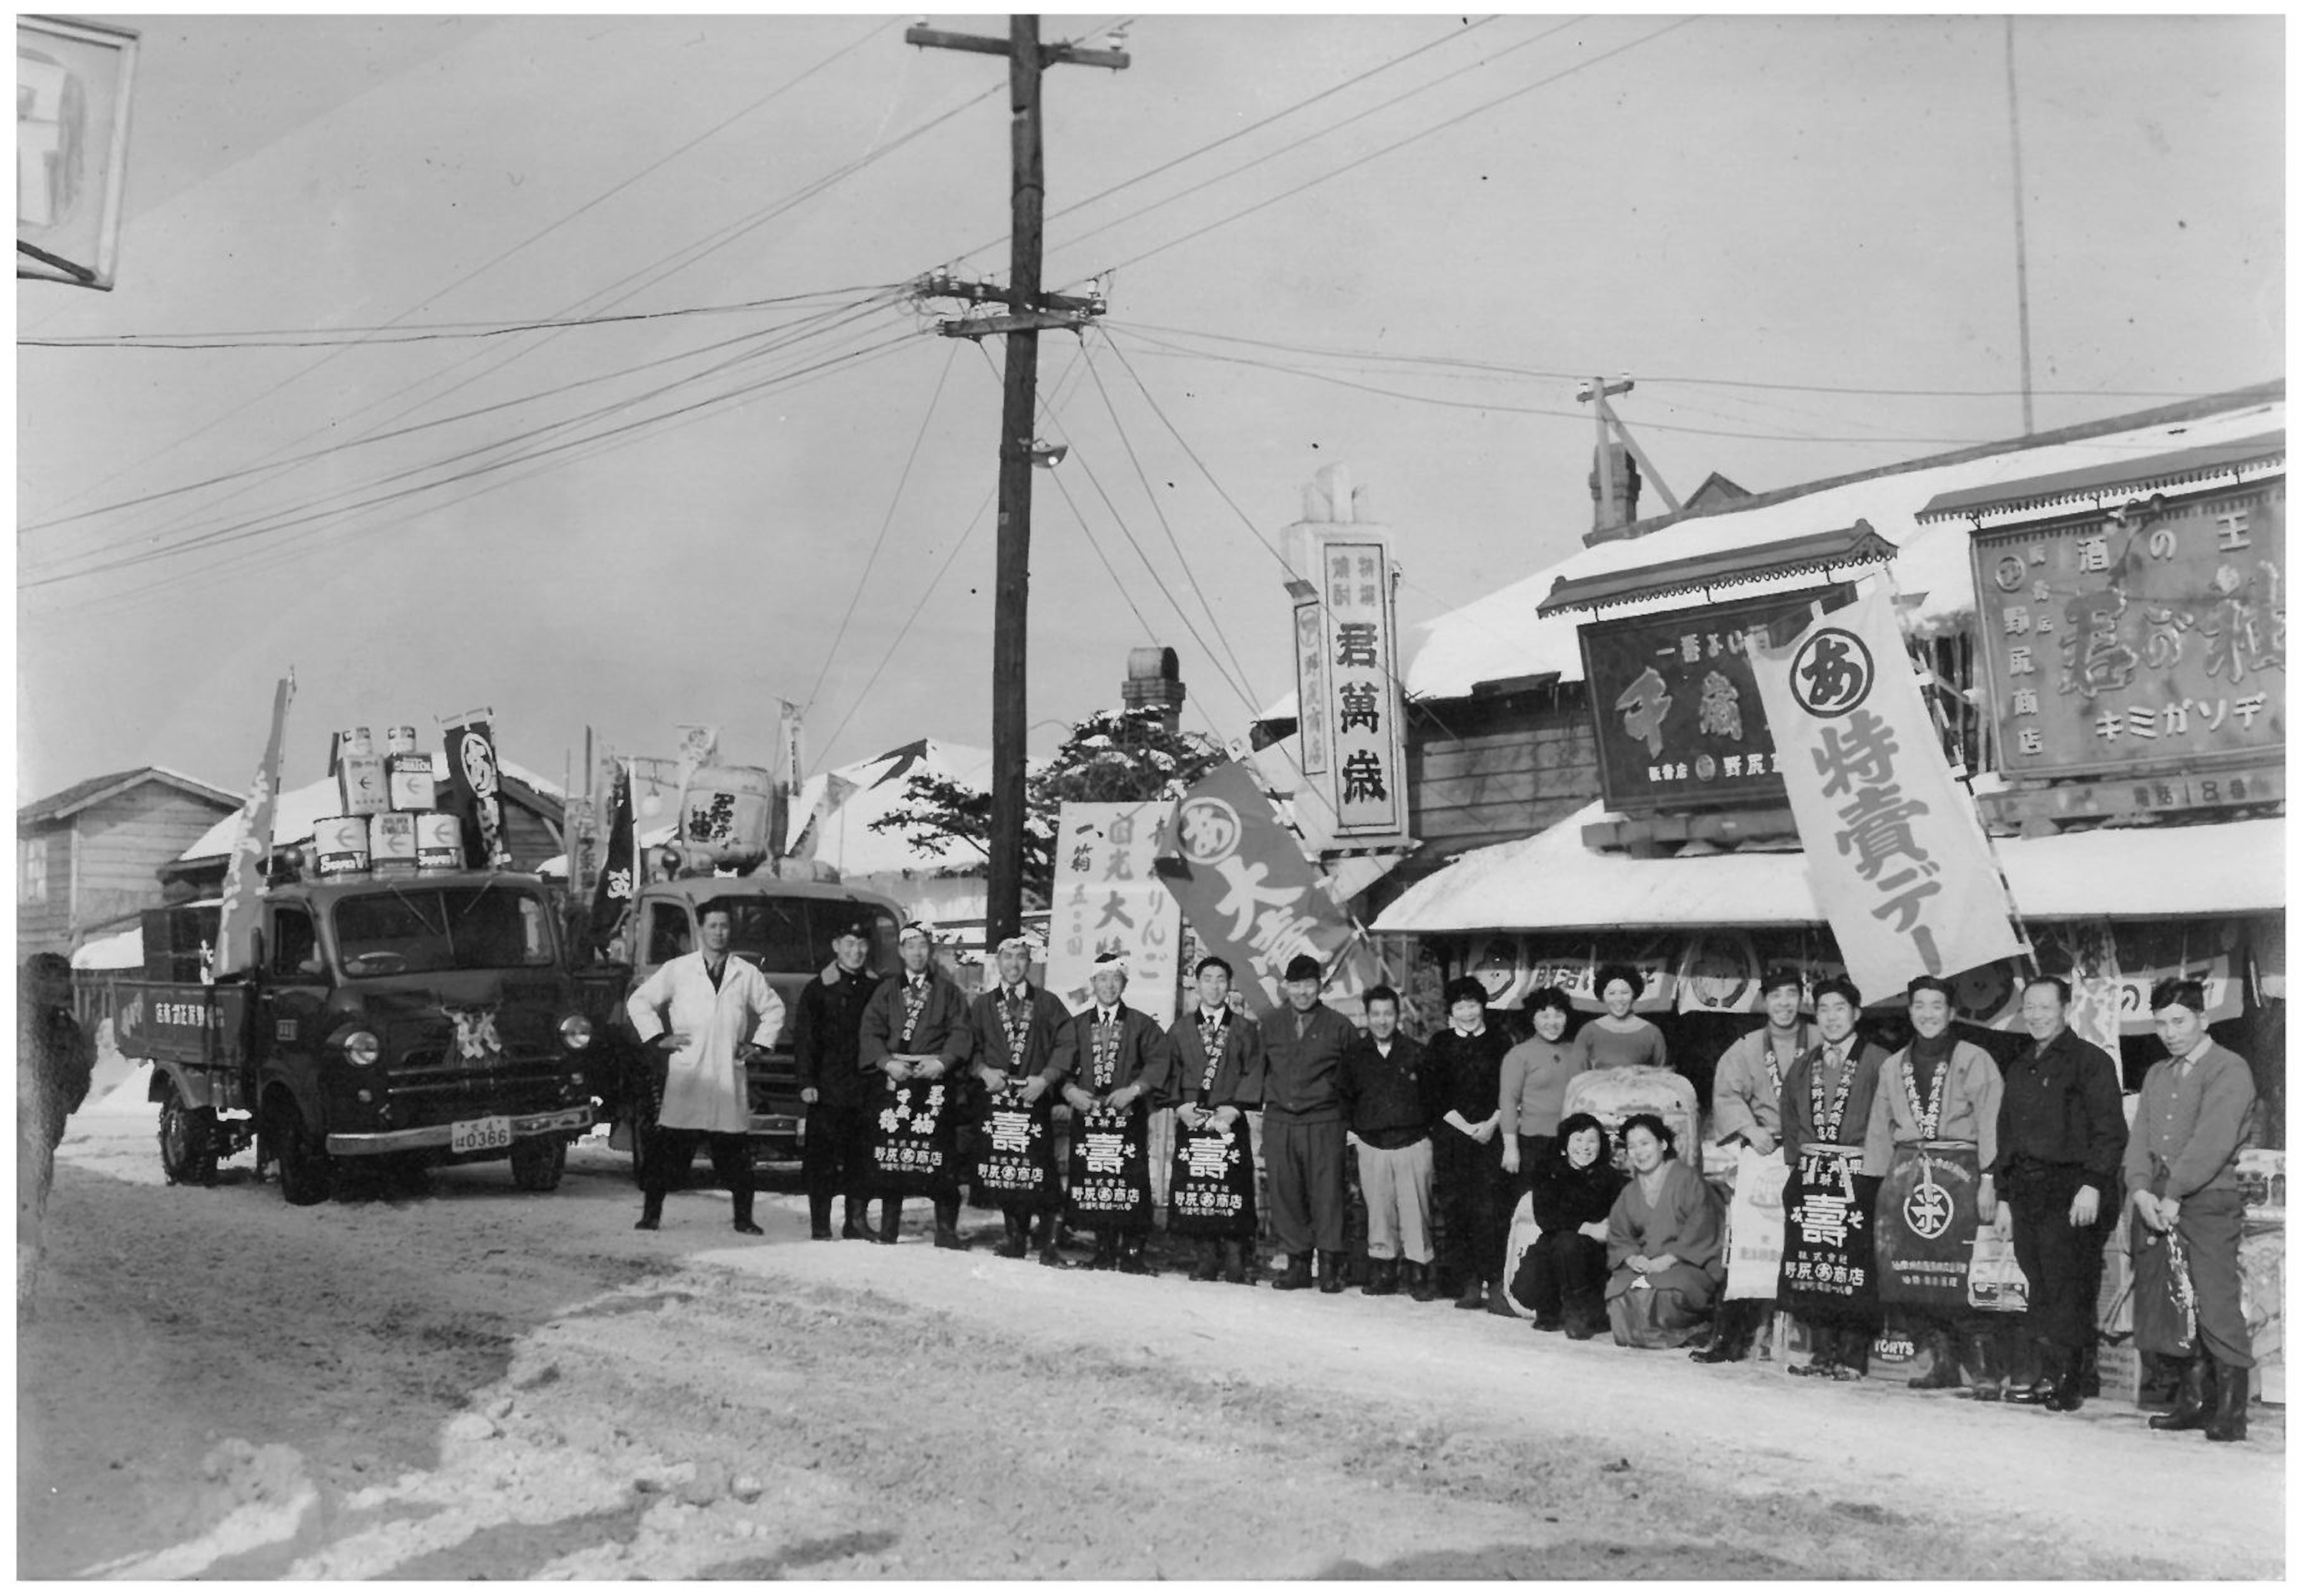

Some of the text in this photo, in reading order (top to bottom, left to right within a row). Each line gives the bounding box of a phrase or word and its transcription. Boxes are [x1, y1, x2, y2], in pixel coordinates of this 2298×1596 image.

[2077, 511, 2251, 574] 酒の王
[1656, 630, 1746, 663] 一番よい
[2003, 606, 2043, 755] 野尻商店
[1615, 665, 1743, 760] 千歳
[2095, 692, 2266, 741] キミガソデ
[1874, 1339, 1914, 1356] TORYS
